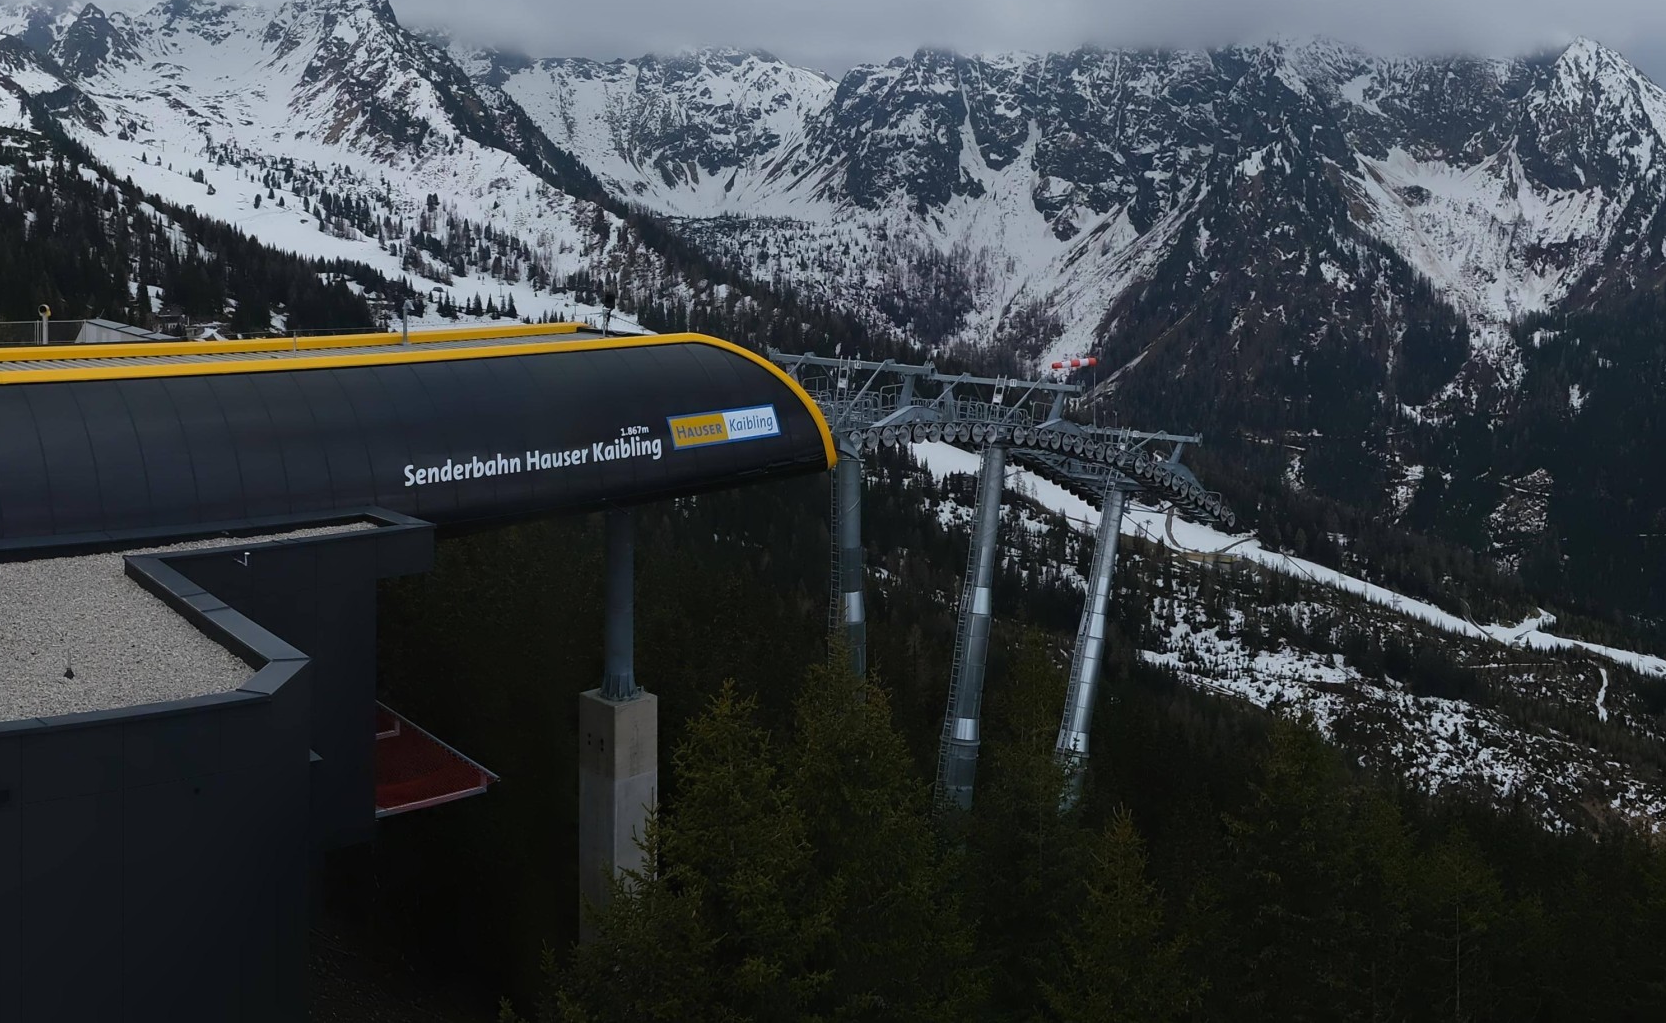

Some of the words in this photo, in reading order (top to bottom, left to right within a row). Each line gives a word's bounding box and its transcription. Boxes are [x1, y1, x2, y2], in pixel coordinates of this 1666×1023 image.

[620, 425, 649, 437] 1.867m
[676, 422, 723, 439] HAUSER
[729, 415, 774, 433] Kaibling
[404, 453, 521, 487] Senderbahn
[526, 447, 589, 472] Hauser
[593, 435, 662, 462] Kaibling
